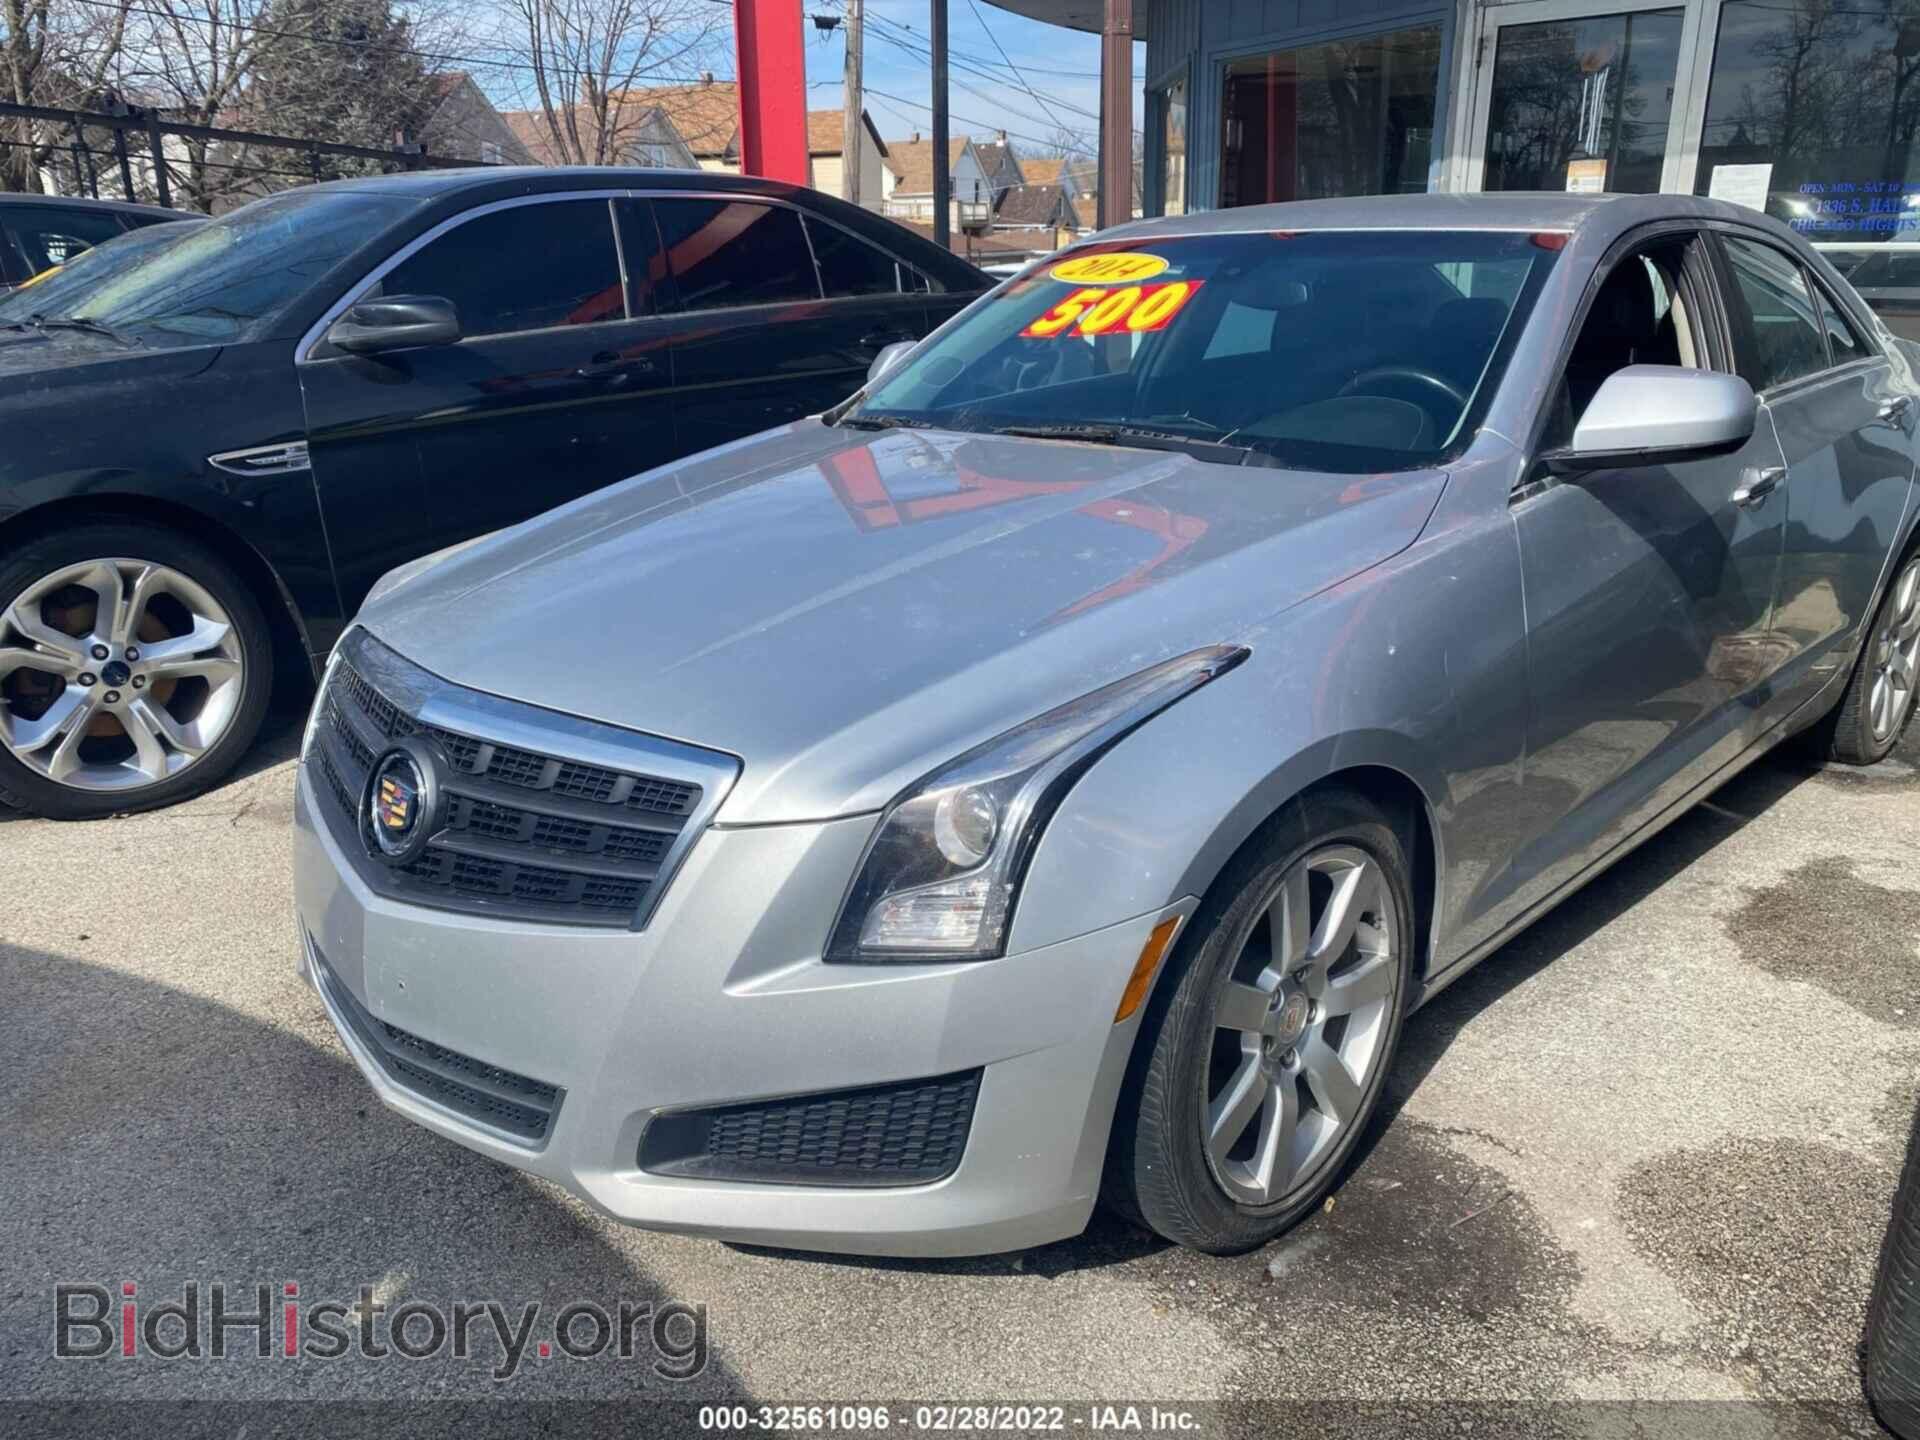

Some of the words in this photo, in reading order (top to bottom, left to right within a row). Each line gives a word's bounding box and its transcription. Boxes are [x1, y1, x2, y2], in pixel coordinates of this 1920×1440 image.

[1863, 181, 1885, 193] SAT
[1058, 257, 1158, 279] 2014
[1029, 281, 1189, 336] 500
